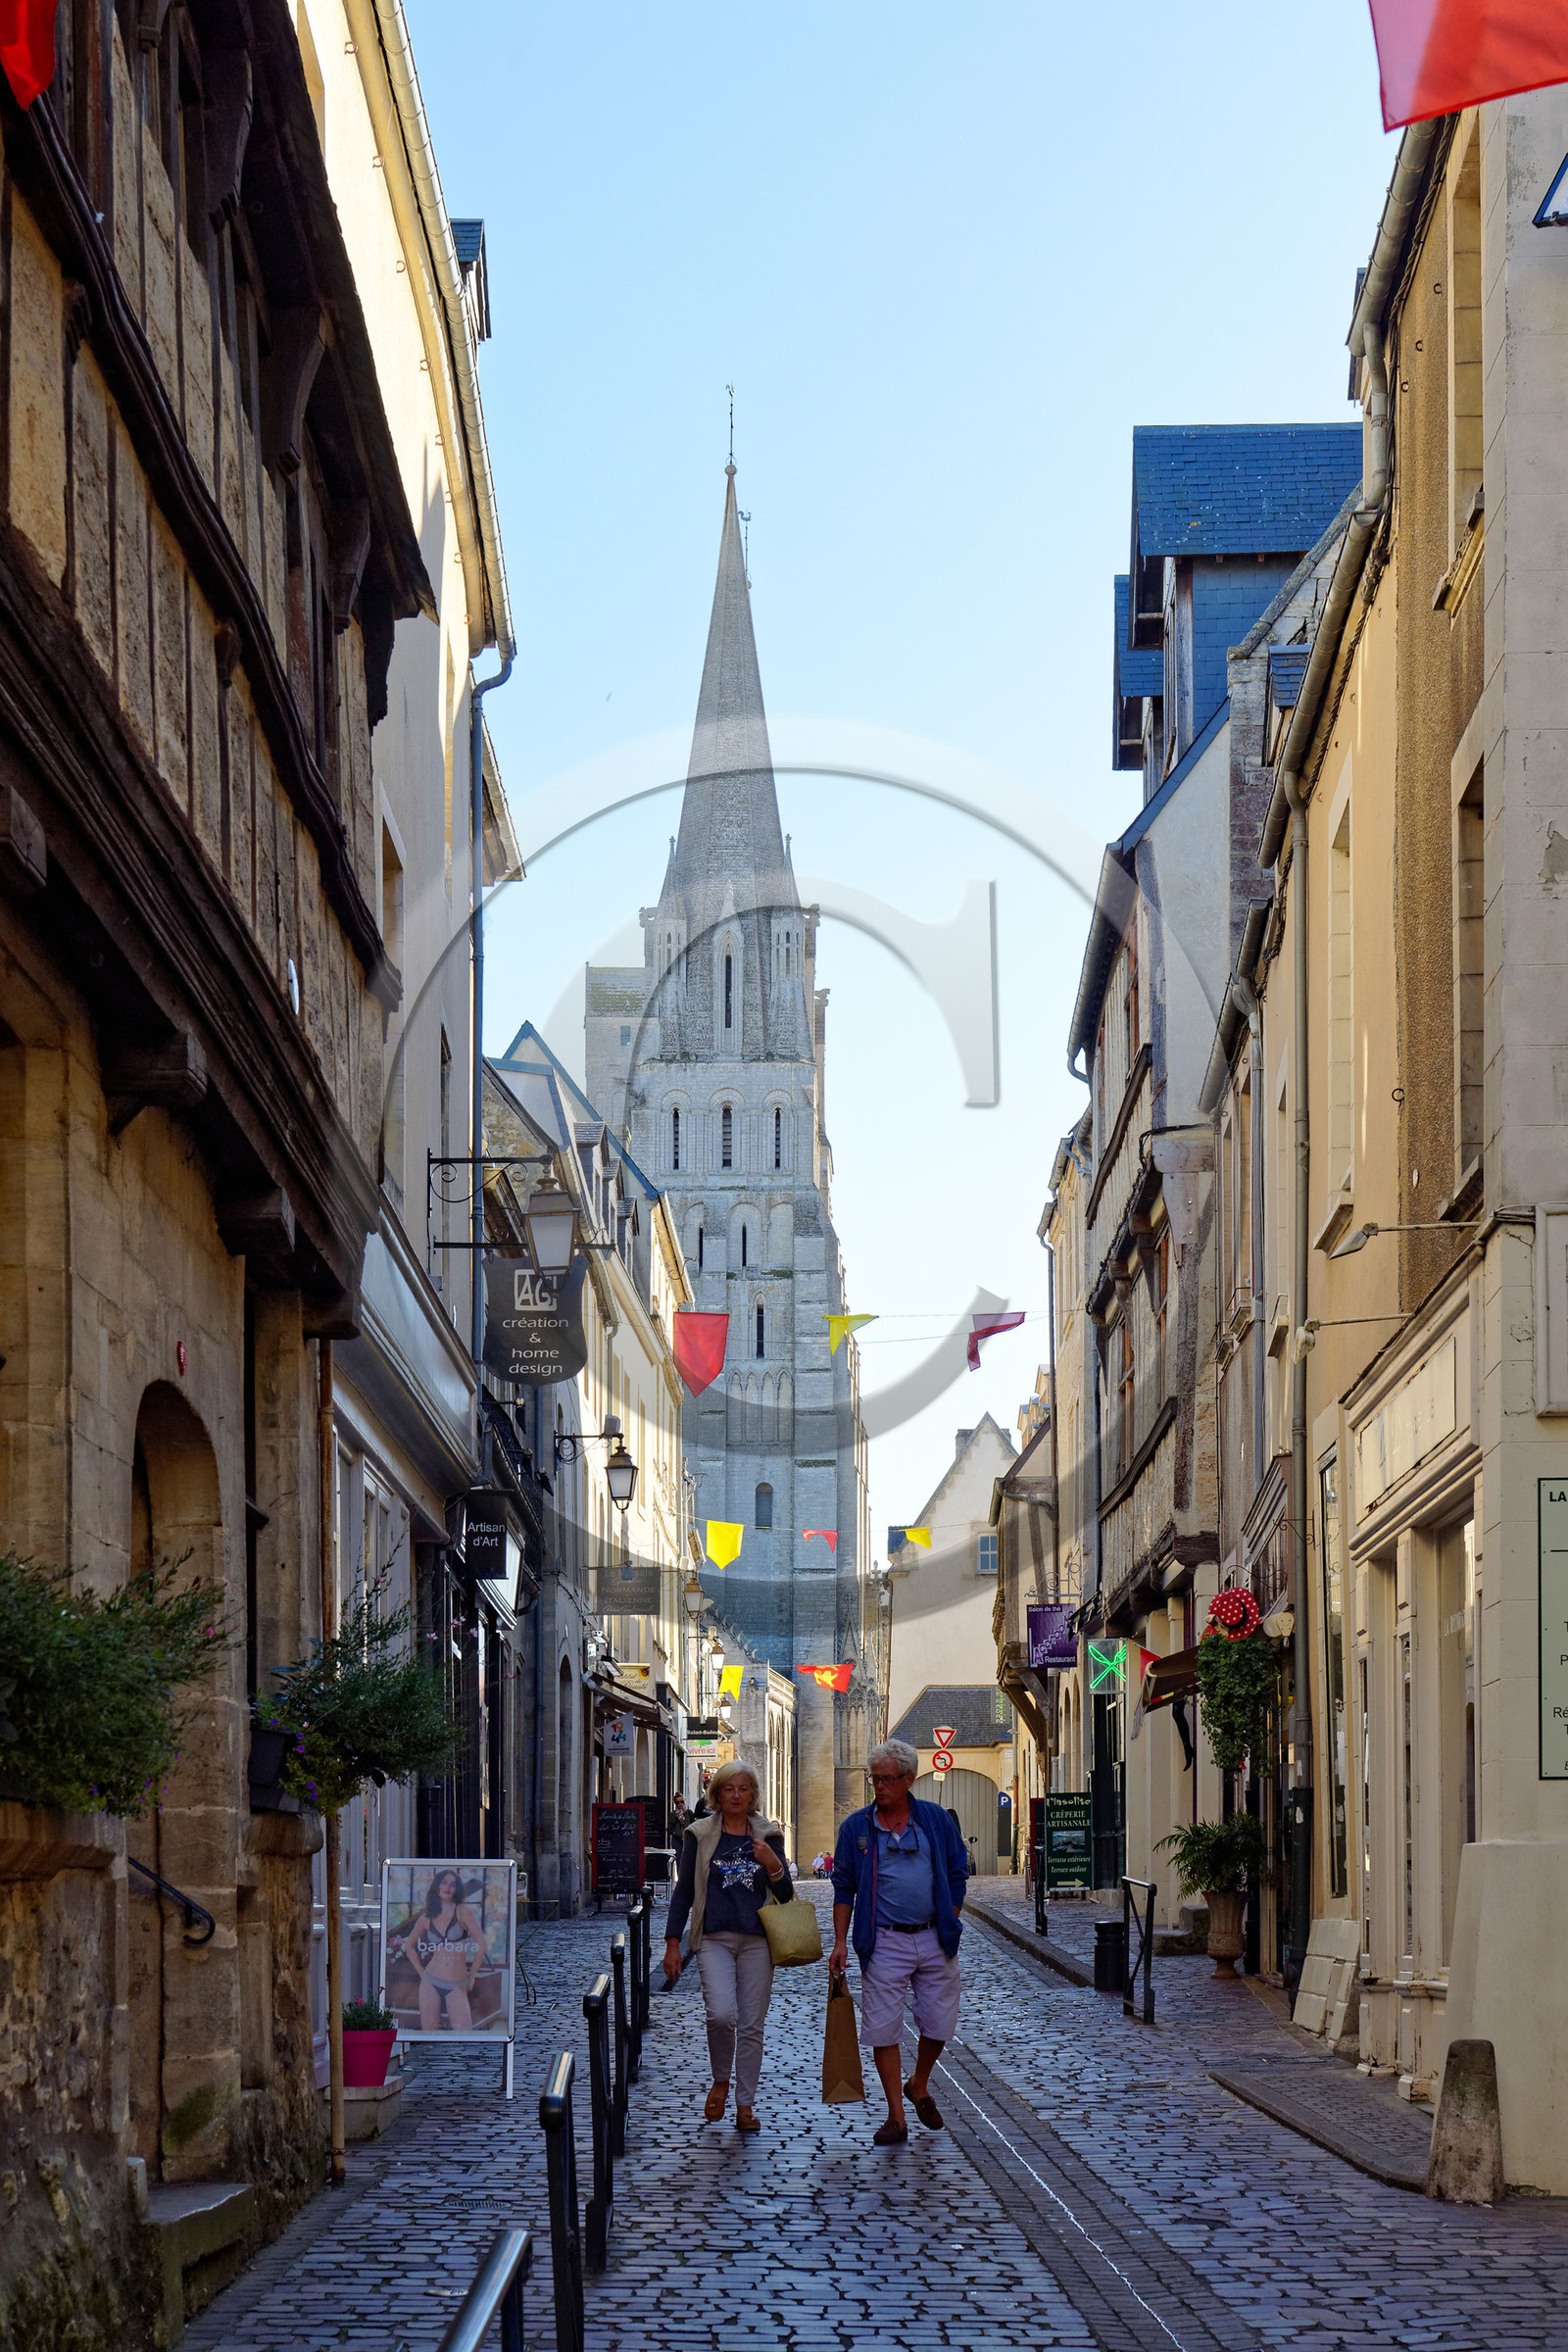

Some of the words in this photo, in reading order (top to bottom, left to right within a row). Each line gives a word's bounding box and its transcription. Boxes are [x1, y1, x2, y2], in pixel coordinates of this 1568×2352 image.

[502, 1317, 568, 1328] création
[529, 1333, 541, 1343] &
[512, 1348, 560, 1358] home
[509, 1363, 563, 1376] design
[1549, 1492, 1567, 1501] LA
[467, 1522, 505, 1532] Artisan
[473, 1537, 498, 1546] d'Art
[1001, 1796, 1008, 1806] P
[417, 1938, 479, 1952] barbara
